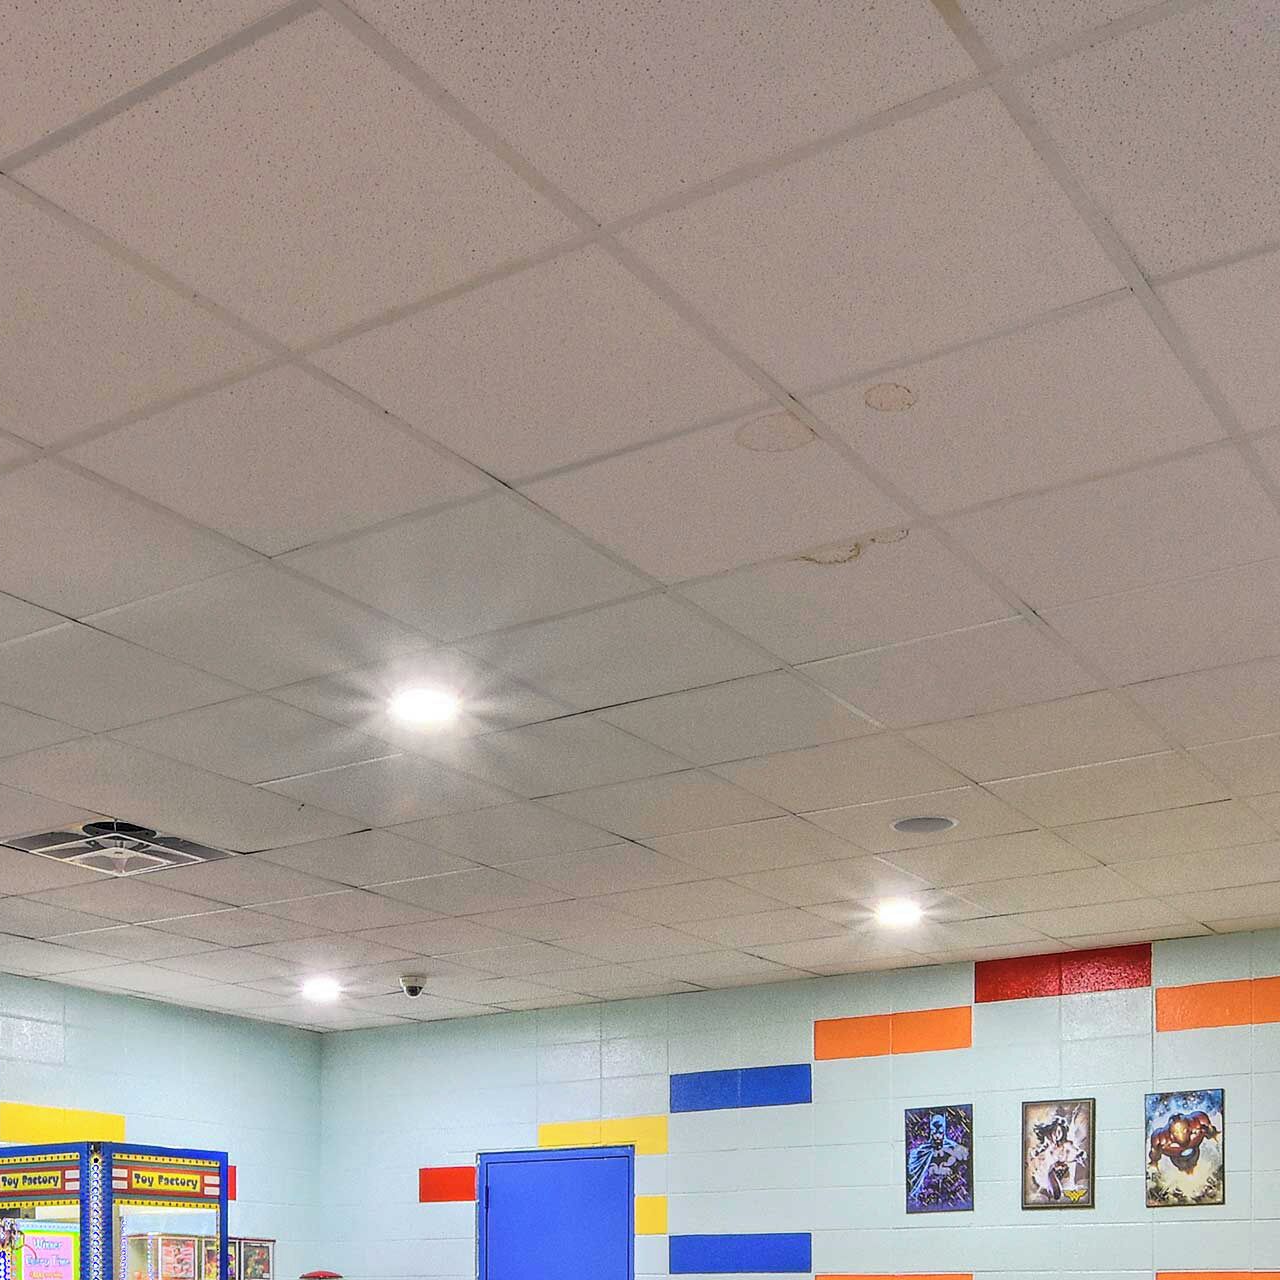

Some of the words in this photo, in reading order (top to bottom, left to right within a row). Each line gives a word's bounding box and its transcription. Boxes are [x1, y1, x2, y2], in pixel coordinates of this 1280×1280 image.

[1, 1175, 19, 1189] Toy
[22, 1174, 59, 1187] Factory
[134, 1172, 154, 1187] Toy
[157, 1174, 198, 1190] Factory
